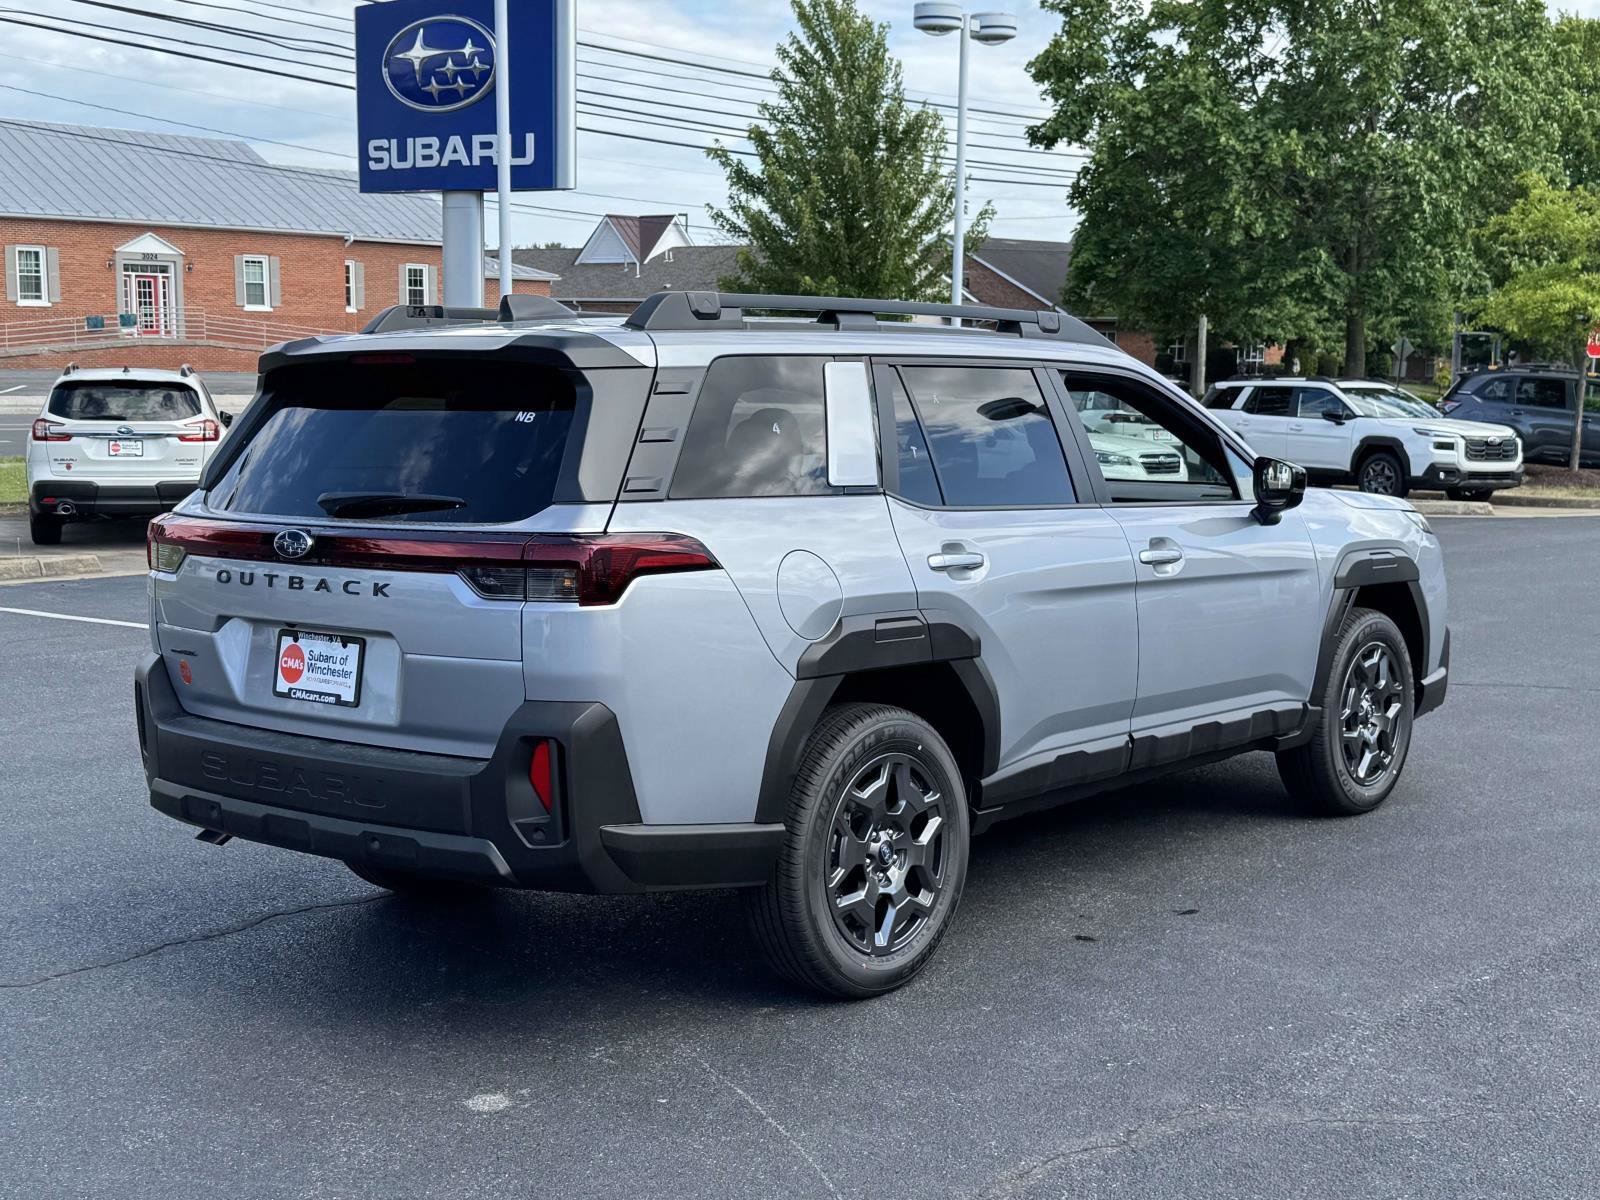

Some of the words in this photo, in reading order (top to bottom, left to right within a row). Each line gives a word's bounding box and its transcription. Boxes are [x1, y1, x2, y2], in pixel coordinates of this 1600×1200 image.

[368, 132, 535, 171] SUBARU
[142, 252, 158, 260] 3024
[216, 569, 391, 598] OUTBACK
[281, 657, 304, 670] CMA's
[307, 650, 337, 664] Subaru
[339, 655, 349, 666] of
[307, 662, 353, 680] Winchester
[290, 689, 336, 703] CMAcars.com
[200, 749, 387, 809] SUBARU
